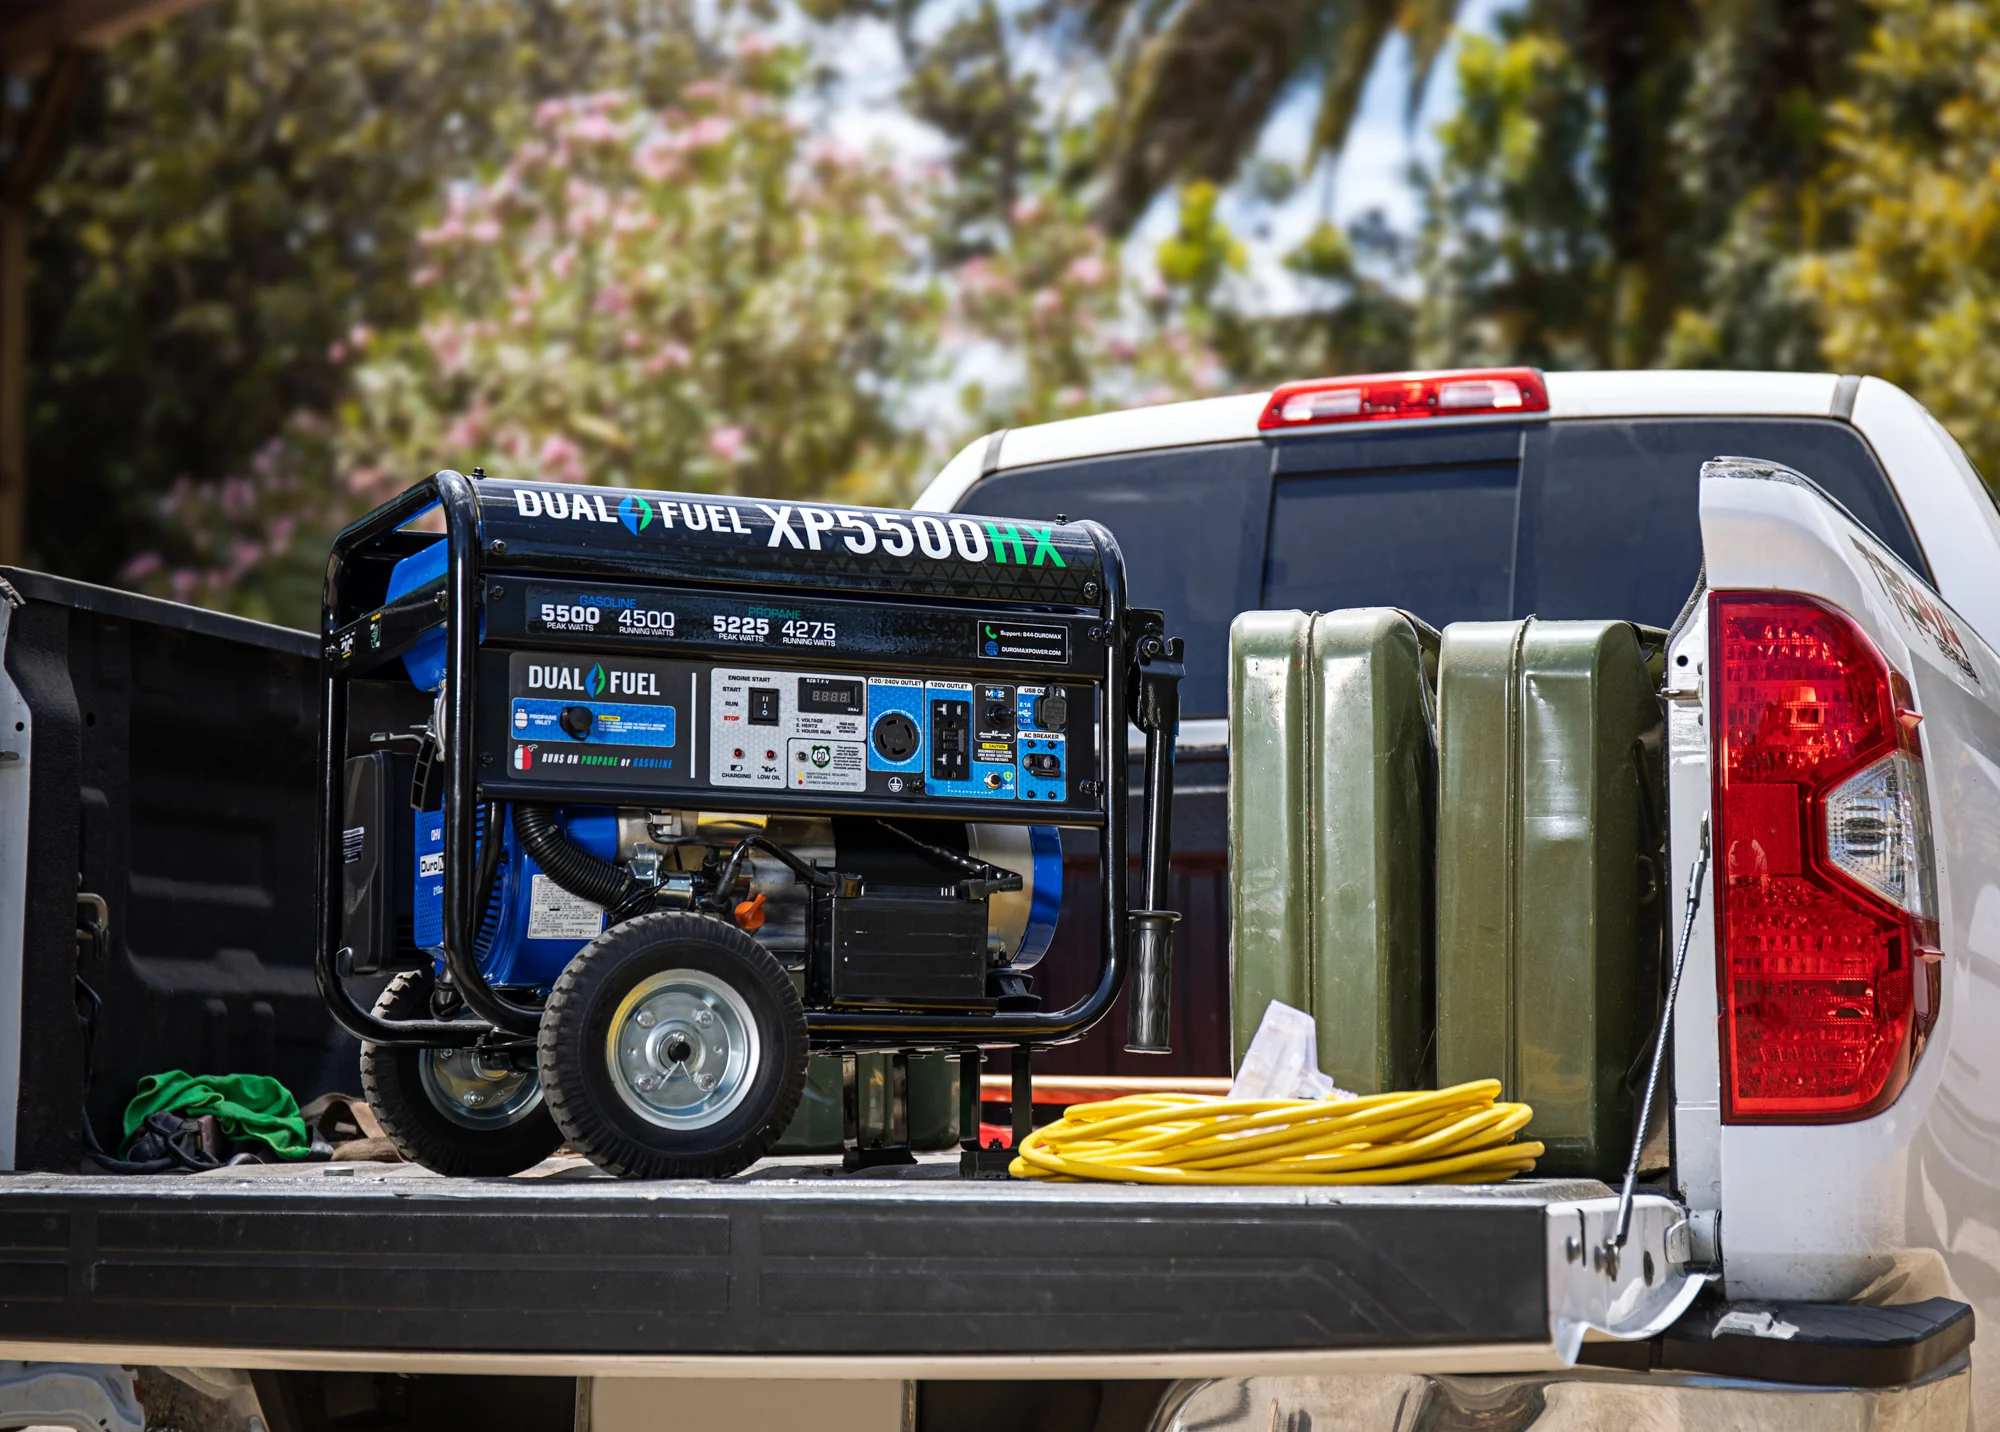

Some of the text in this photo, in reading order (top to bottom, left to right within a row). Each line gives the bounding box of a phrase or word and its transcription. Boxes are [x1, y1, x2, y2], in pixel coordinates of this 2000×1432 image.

[513, 490, 1067, 568] DUAL FUEL XP5500HX
[579, 595, 636, 608] GASOLINE
[541, 604, 675, 629] 5500 4500
[748, 606, 801, 620] PROPANE
[568, 623, 594, 632] WATTS
[619, 626, 674, 636] RUNNING WATTS
[713, 615, 836, 640] 5225 4275
[739, 634, 764, 642] WATTS
[1000, 630, 1022, 638] Support:
[782, 637, 836, 646] RUNNING WATTS
[1002, 646, 1062, 656] DUROMAXPOWER.COM
[528, 665, 660, 696] DUAL FUEL
[986, 688, 1004, 699] MX2
[542, 753, 673, 769] RUNS ON PROPANE or GASOLINE
[816, 752, 826, 760] CO
[431, 828, 441, 841] OHV
